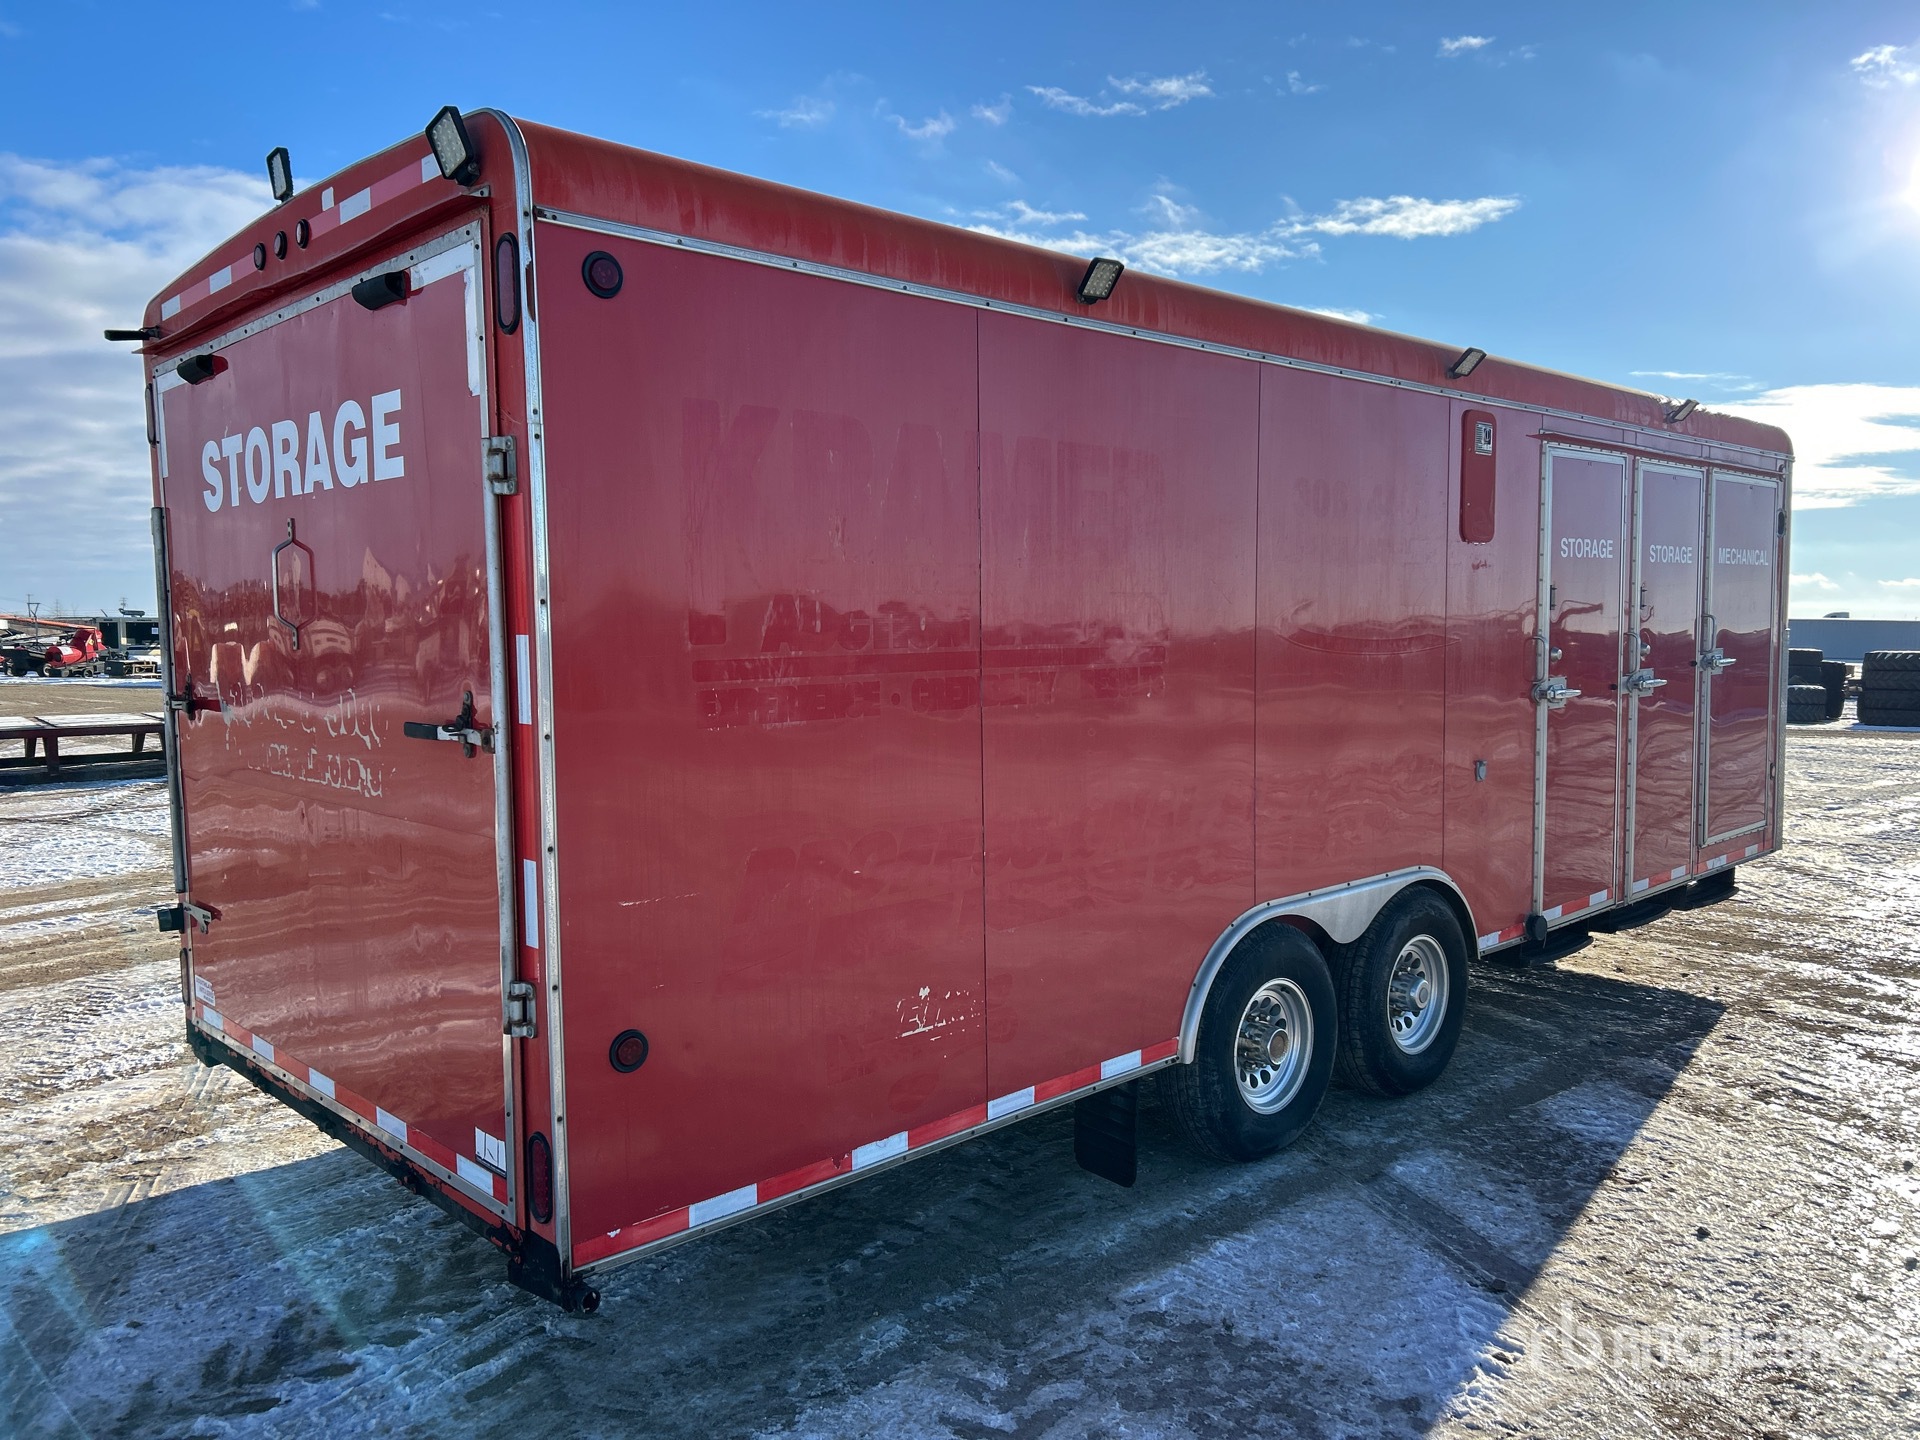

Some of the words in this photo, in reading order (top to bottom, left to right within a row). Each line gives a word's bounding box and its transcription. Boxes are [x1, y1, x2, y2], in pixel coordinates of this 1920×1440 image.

[201, 388, 405, 512] STORAGE
[1560, 536, 1613, 559] STORAGE
[1649, 544, 1693, 564] STORAGE
[1718, 547, 1769, 566] MECHANICAL
